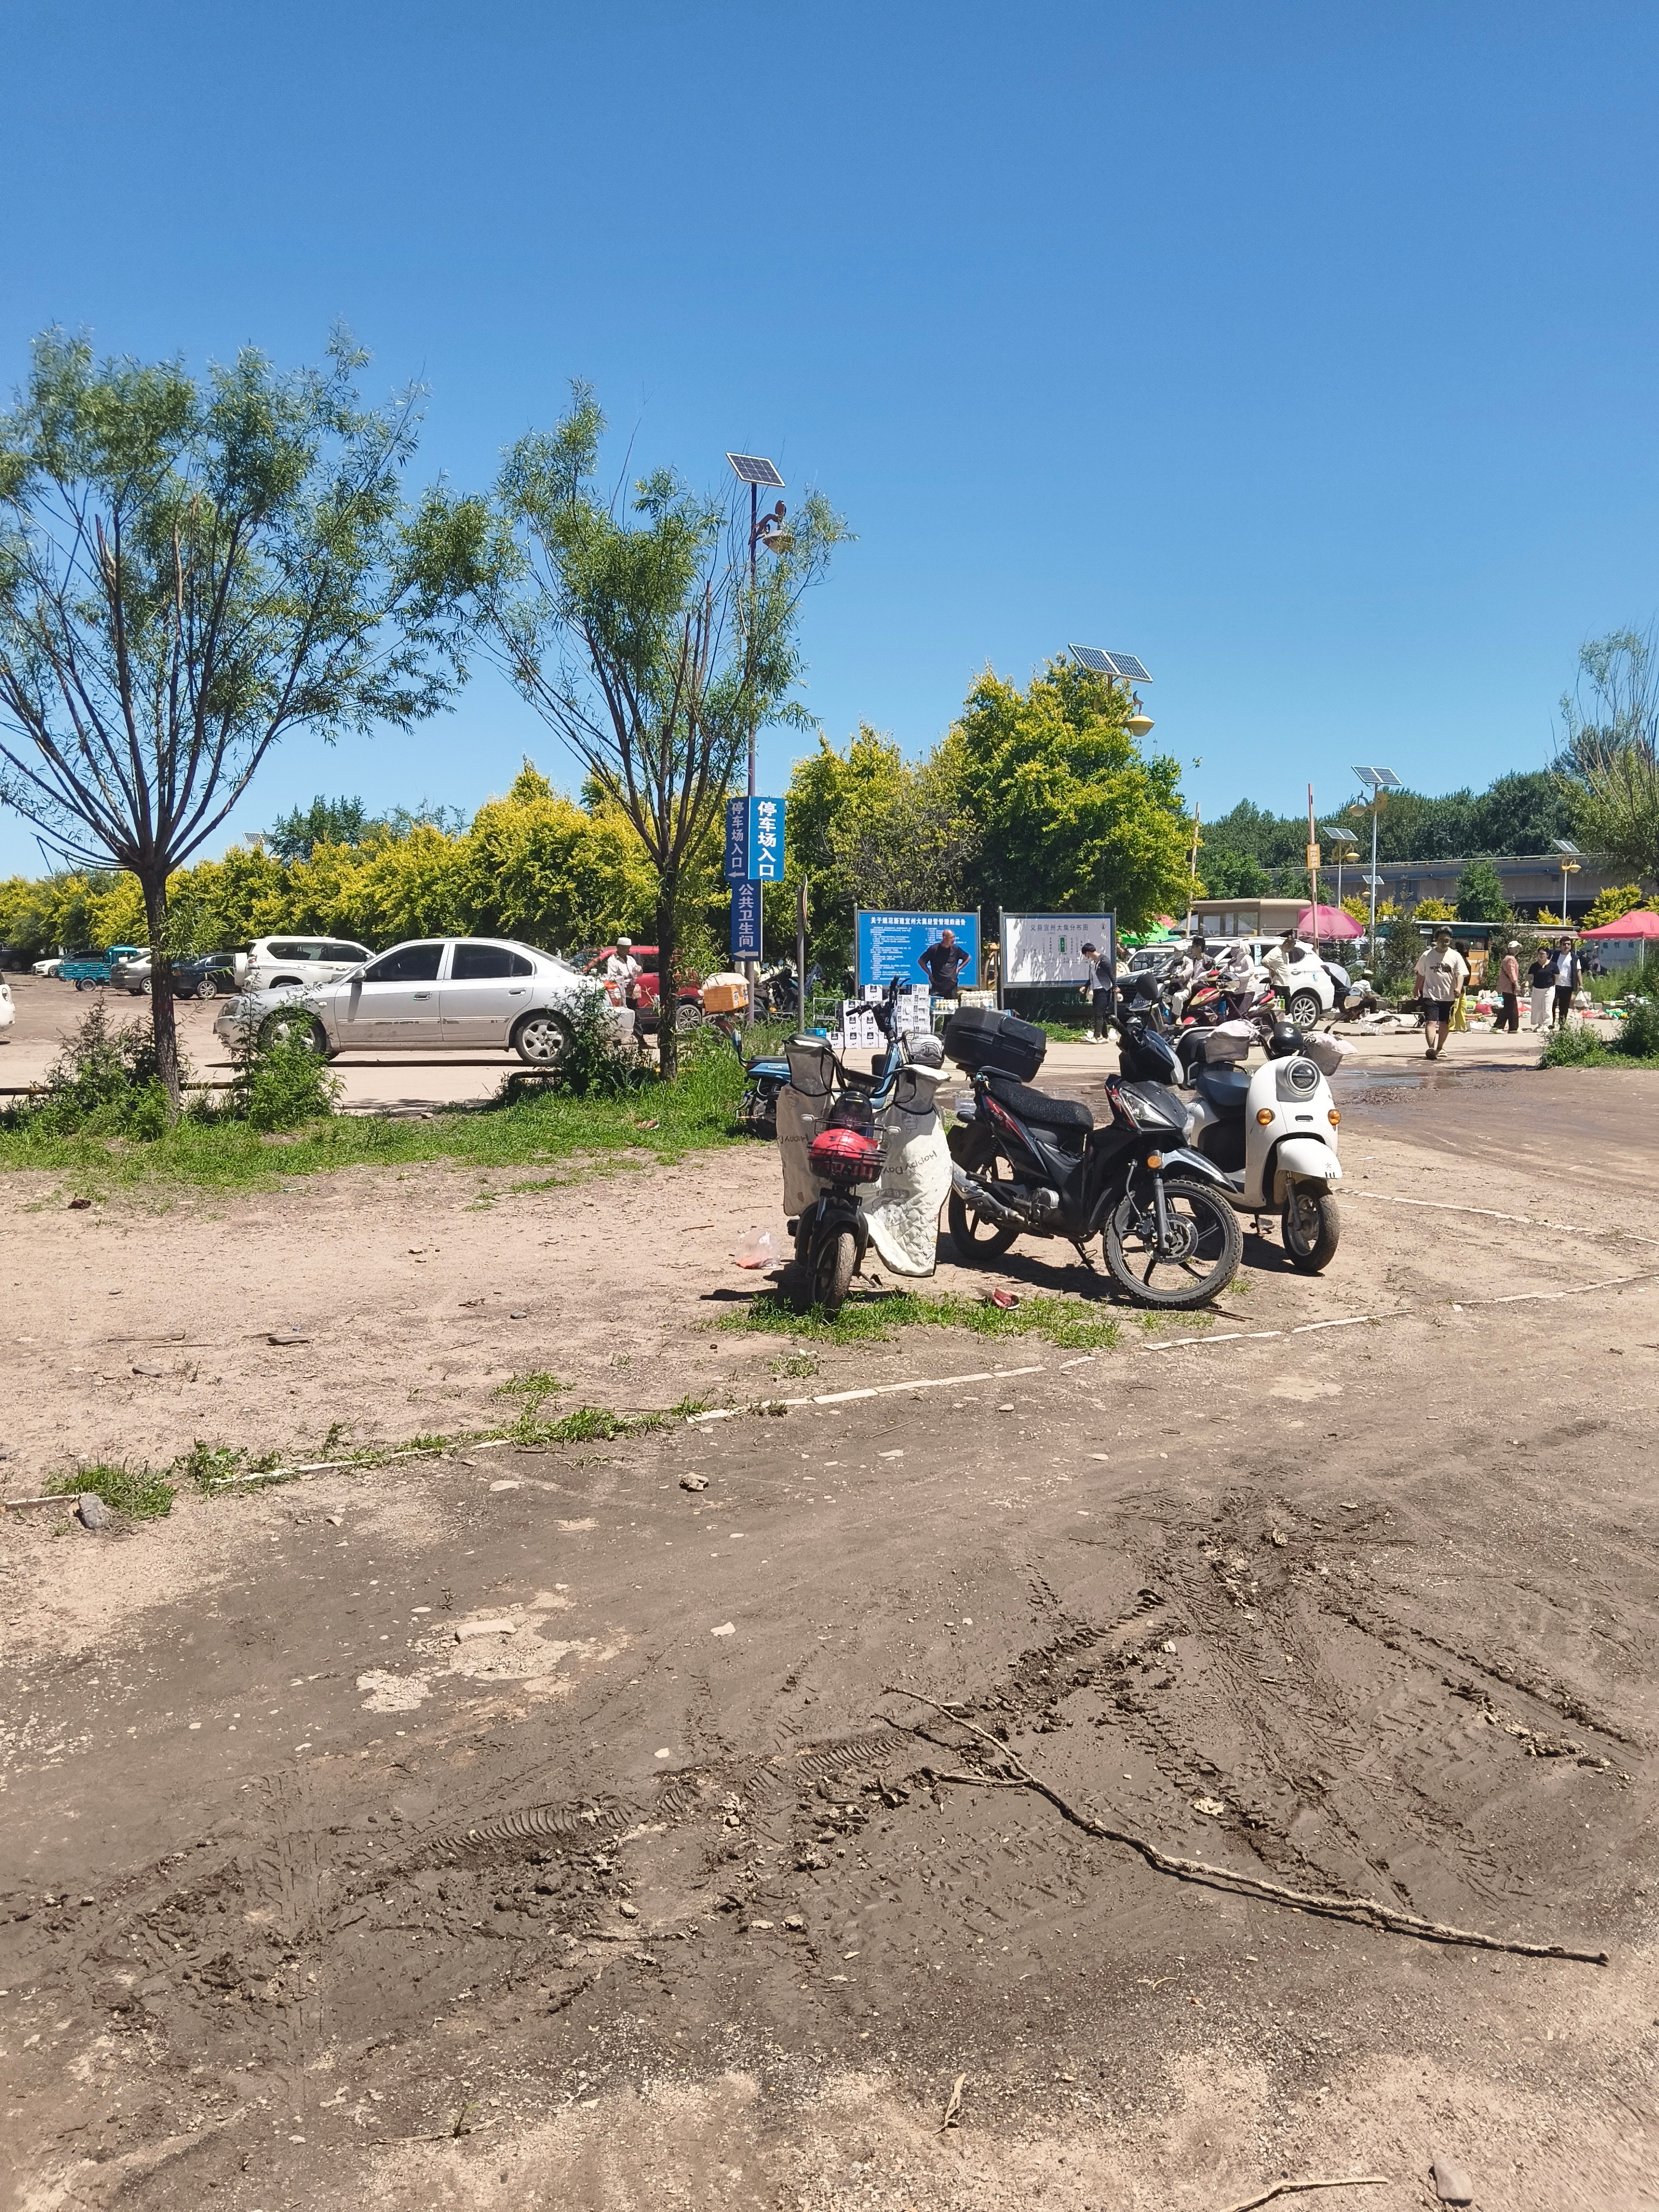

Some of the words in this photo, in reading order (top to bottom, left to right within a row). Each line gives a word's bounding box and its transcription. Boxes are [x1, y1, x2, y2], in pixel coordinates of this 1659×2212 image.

[731, 801, 744, 868] 停车场入口
[758, 801, 777, 877] 停车场入口
[738, 884, 754, 947] 公共卫生间
[883, 1166, 903, 1175] Day
[906, 1150, 937, 1170] Happy
